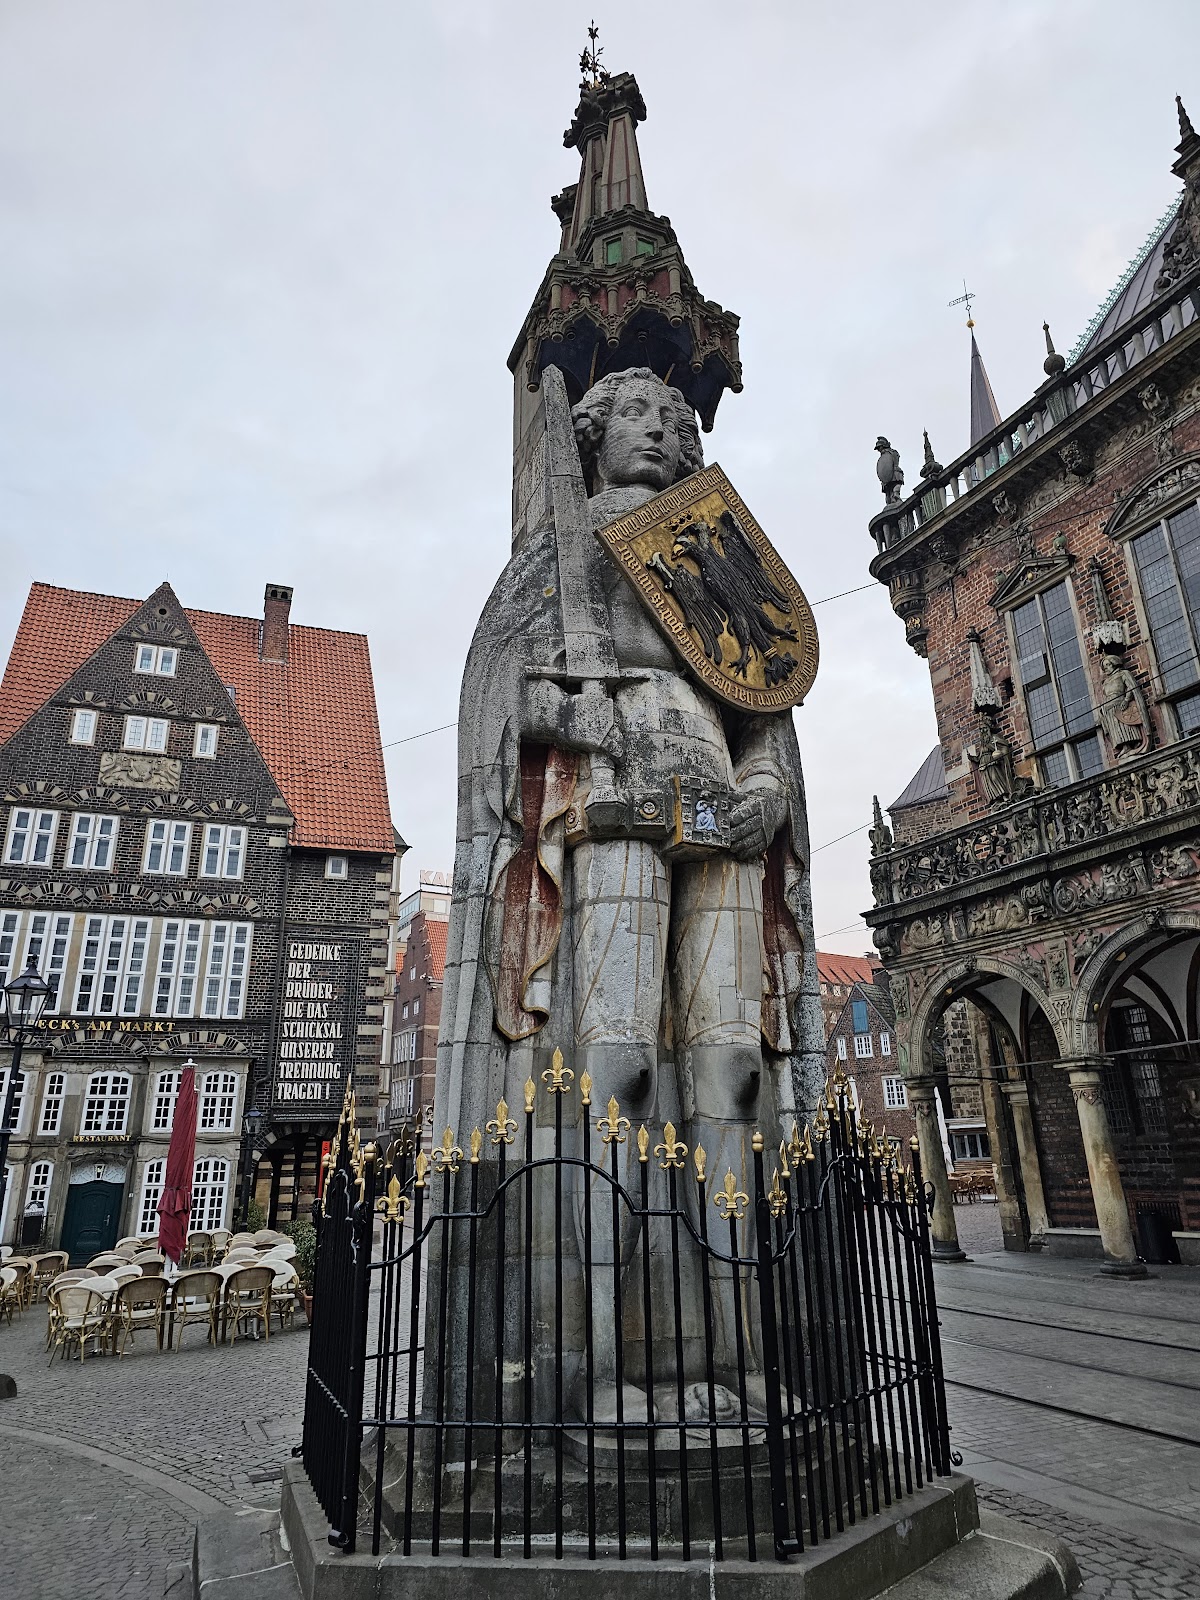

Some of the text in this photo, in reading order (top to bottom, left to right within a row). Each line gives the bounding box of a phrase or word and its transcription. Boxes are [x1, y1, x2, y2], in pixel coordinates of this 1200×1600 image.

[290, 943, 341, 961] GEDENKE
[288, 962, 311, 979] DER
[286, 980, 338, 1000] BRÜDER,
[284, 1001, 328, 1019] DIE DAS
[88, 1021, 112, 1031] AM
[119, 1021, 176, 1032] MARKT
[282, 1021, 343, 1039] SCHICKSAL
[280, 1041, 334, 1059] UNSERER
[279, 1062, 341, 1079] TRENNUNG
